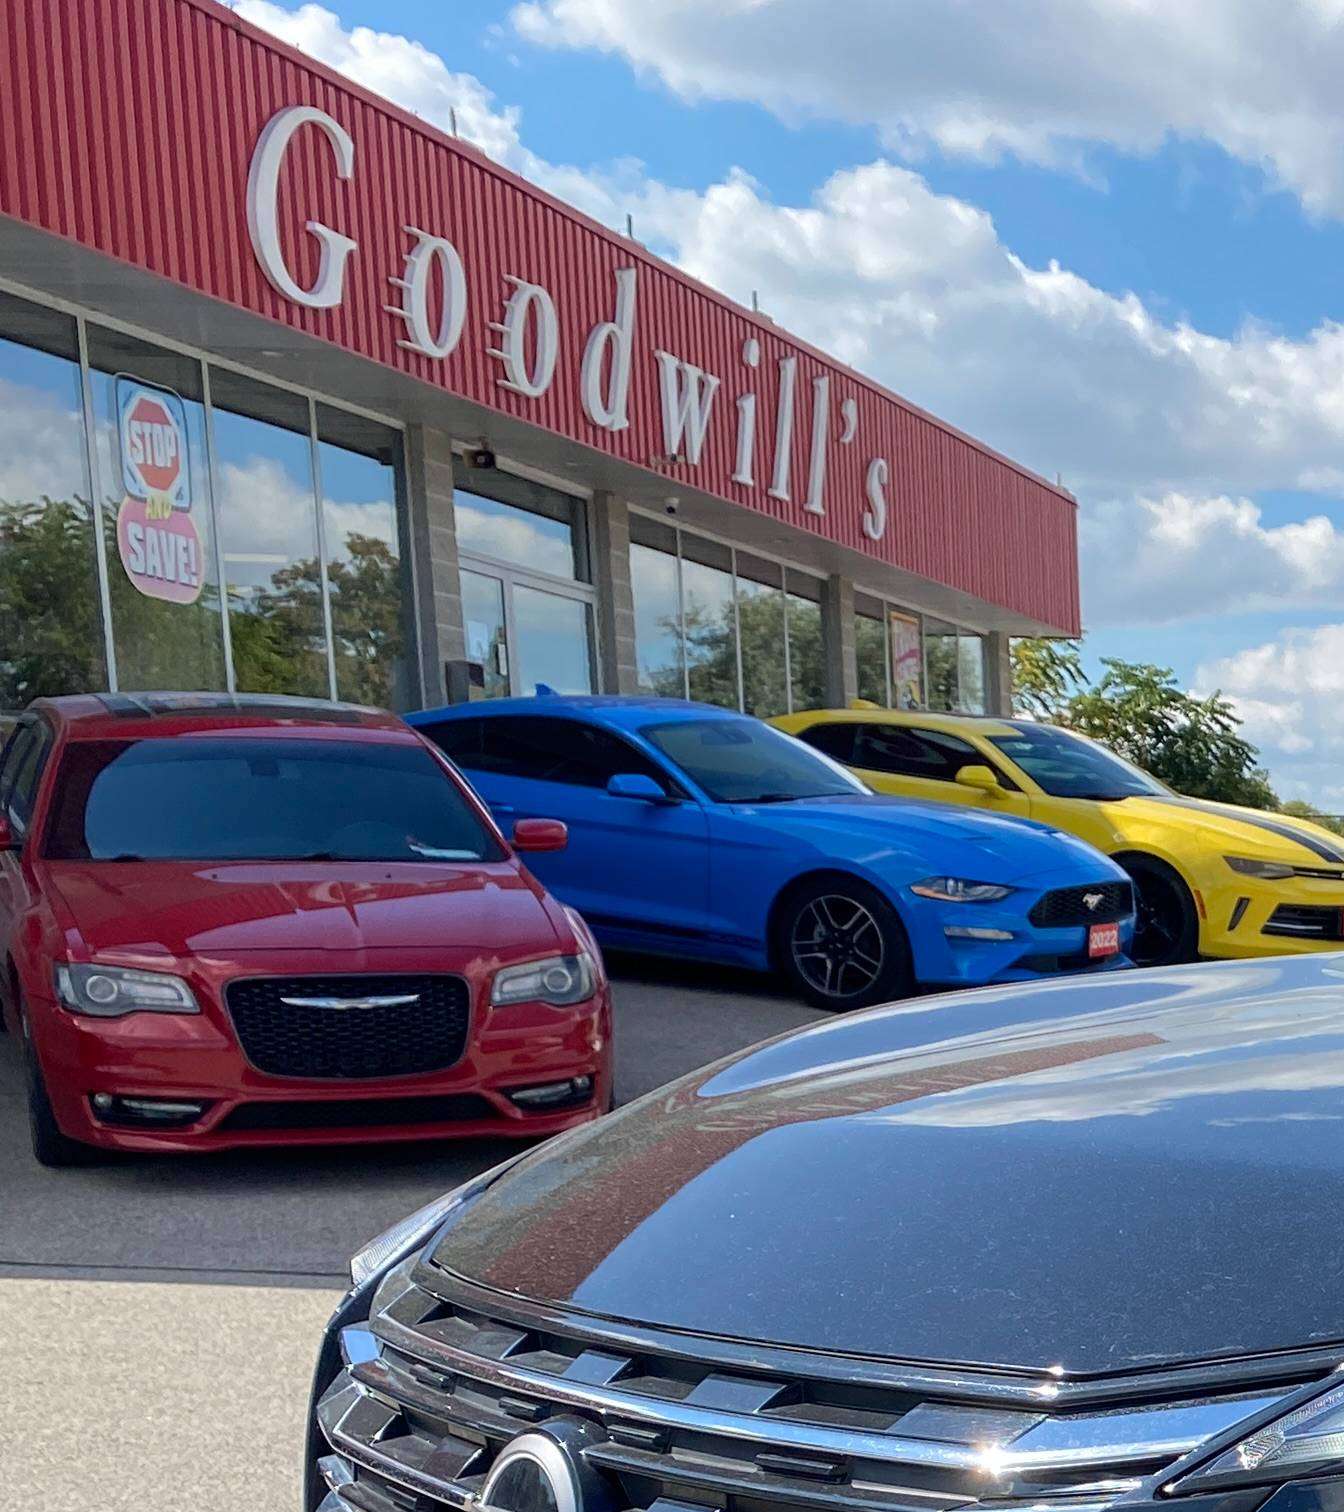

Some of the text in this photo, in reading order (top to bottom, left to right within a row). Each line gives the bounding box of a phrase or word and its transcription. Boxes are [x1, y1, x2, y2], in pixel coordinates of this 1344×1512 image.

[247, 106, 889, 541] Goodwill's
[129, 420, 177, 468] STOP
[145, 495, 173, 520] AND
[127, 520, 198, 588] SAVE!
[1090, 930, 1118, 949] 2022
